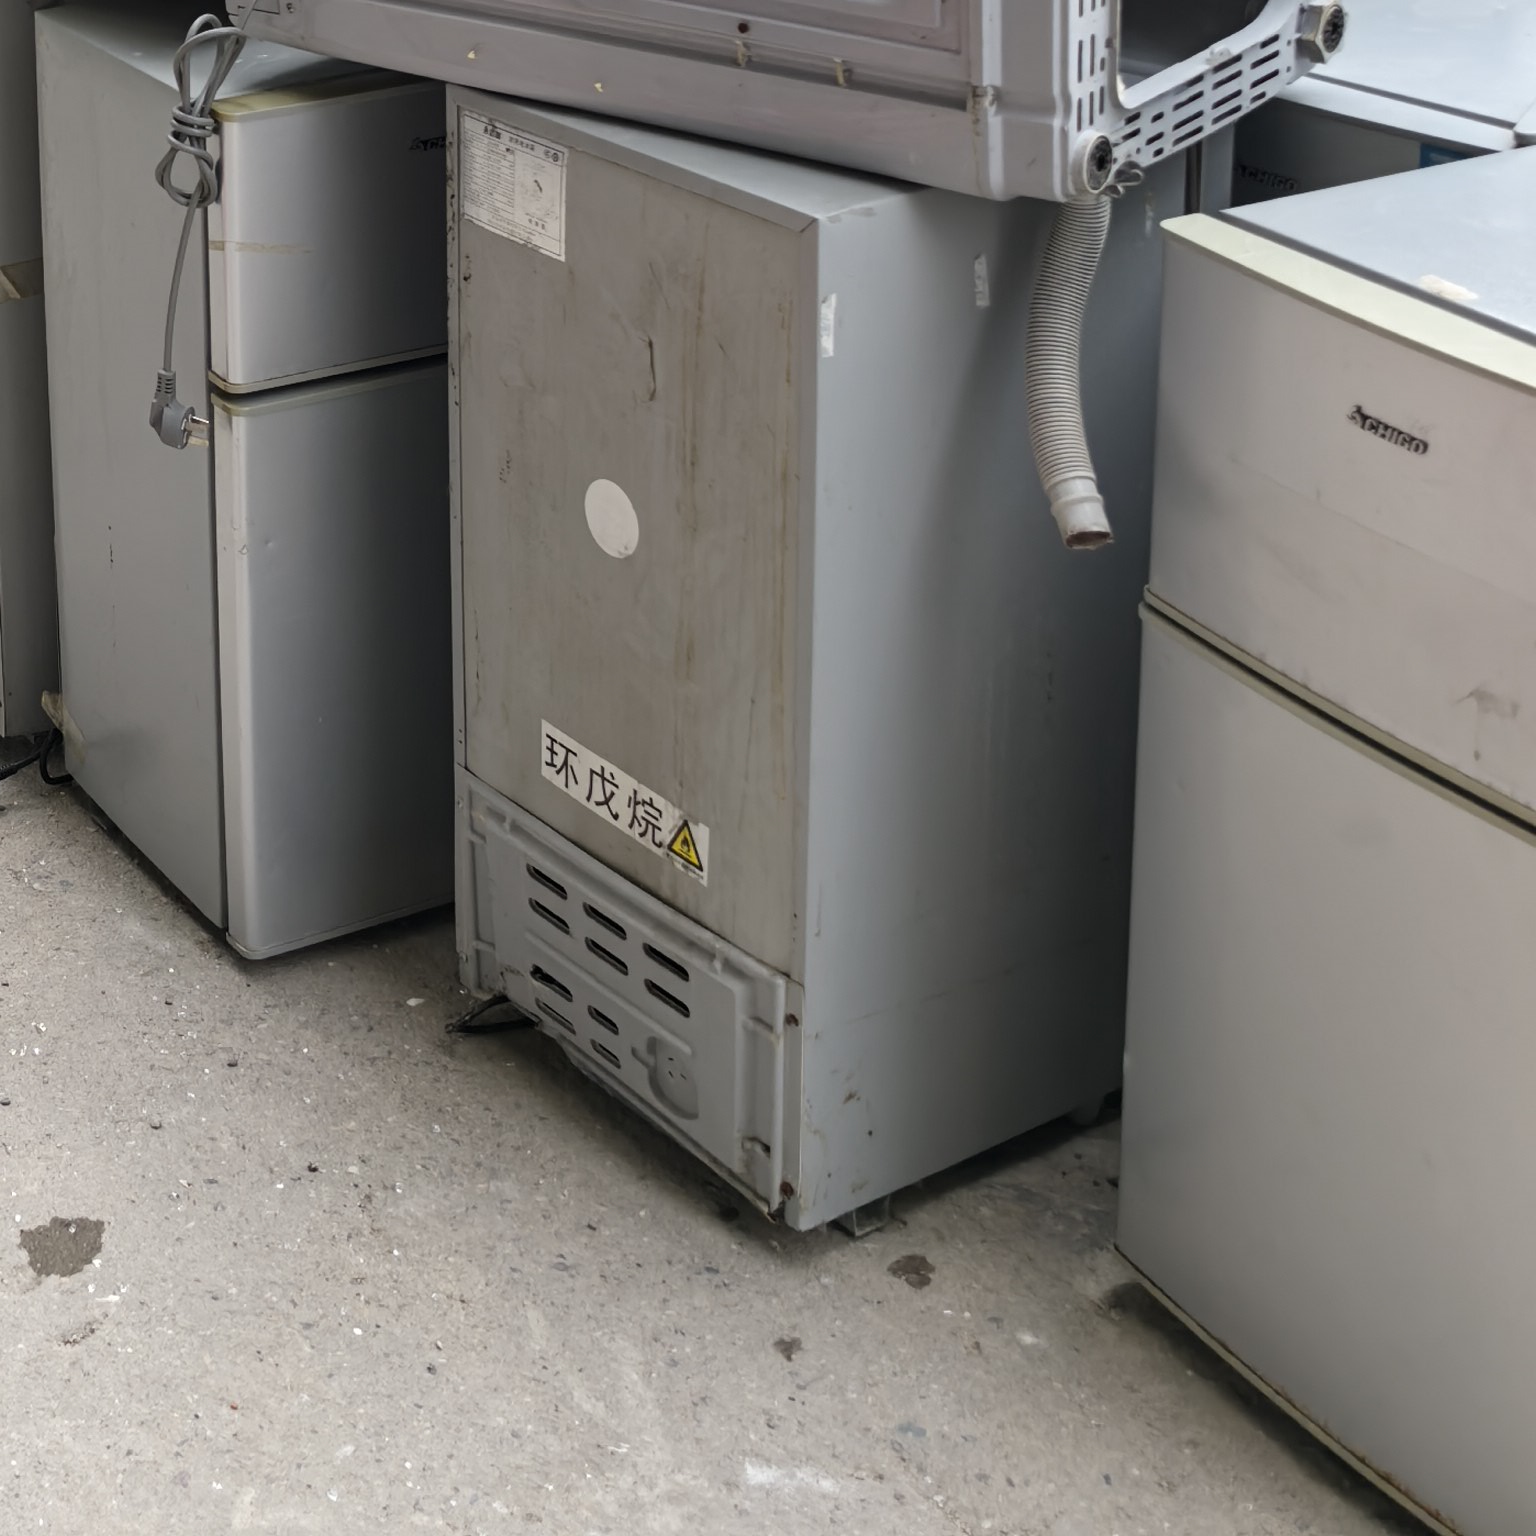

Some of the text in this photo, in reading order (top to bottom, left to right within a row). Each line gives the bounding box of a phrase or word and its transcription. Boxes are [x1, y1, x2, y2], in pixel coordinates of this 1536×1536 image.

[1362, 415, 1428, 455] CHIGO
[544, 732, 664, 849] 环戊烷
